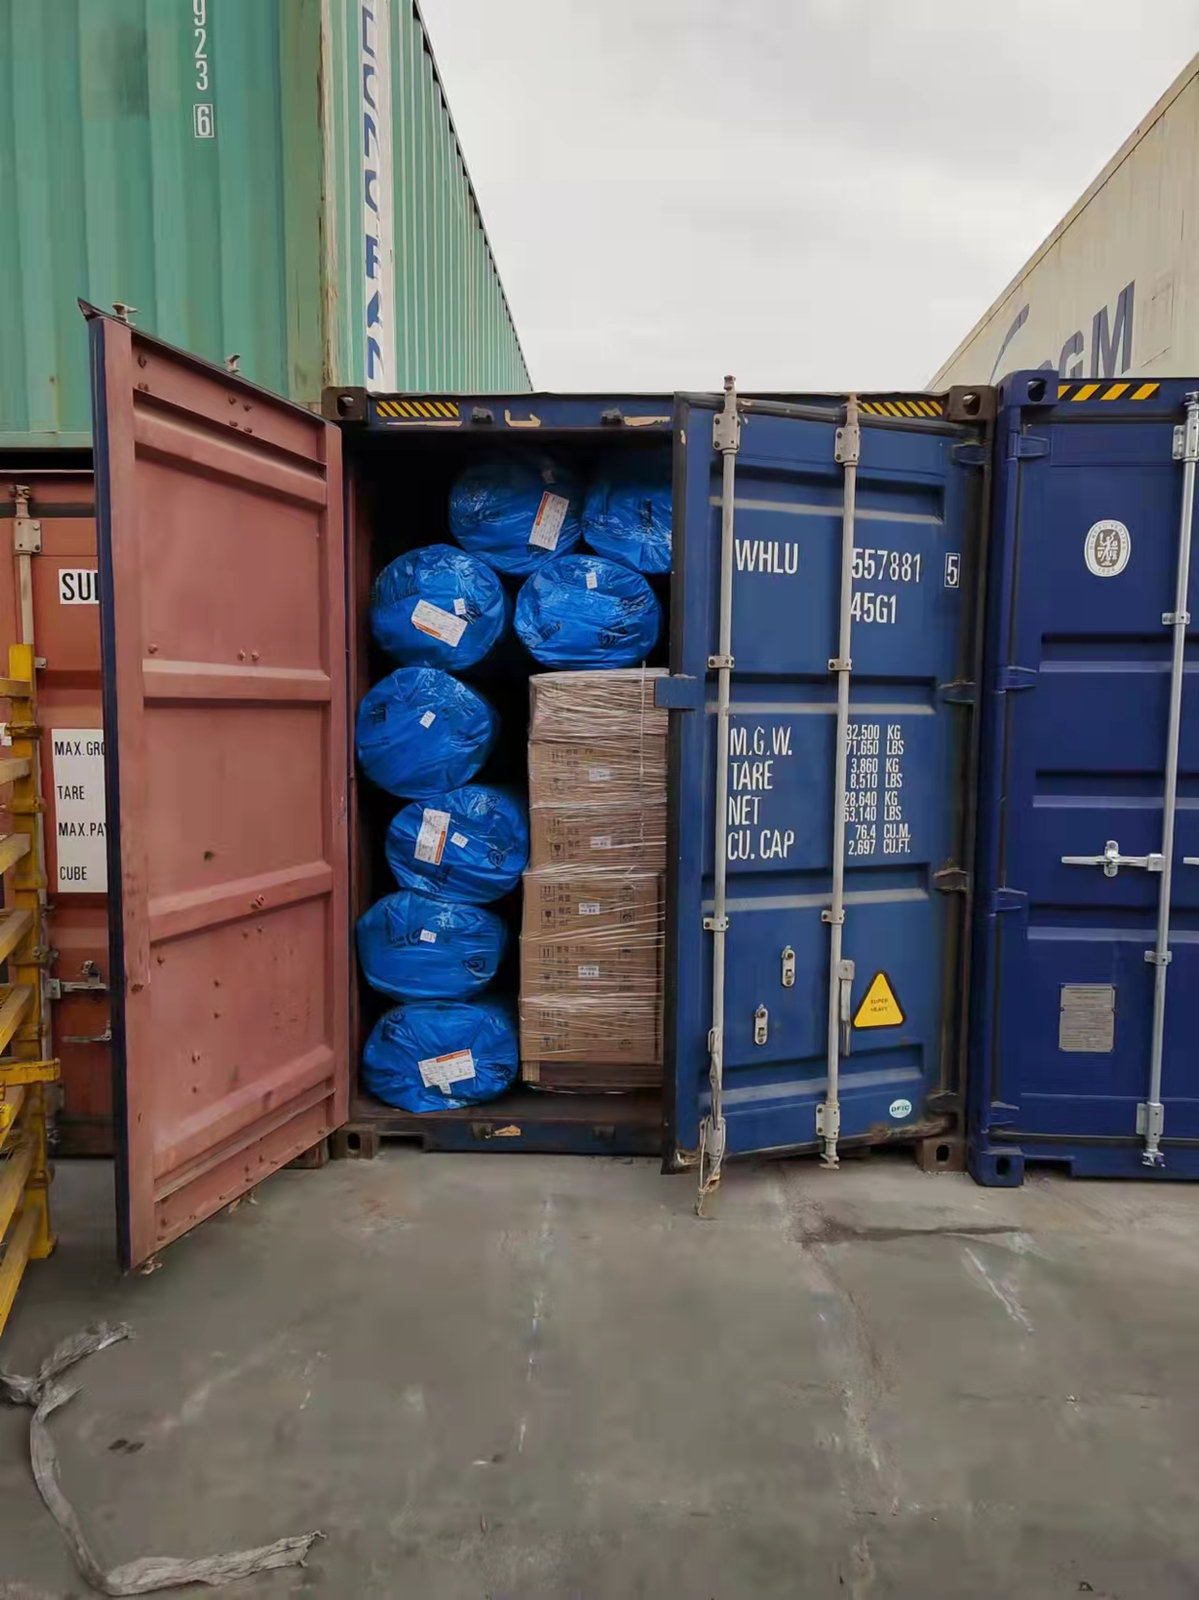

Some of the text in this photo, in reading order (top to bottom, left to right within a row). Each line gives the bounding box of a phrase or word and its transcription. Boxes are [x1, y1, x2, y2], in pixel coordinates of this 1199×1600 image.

[196, 105, 211, 137] 6
[735, 539, 959, 586] WHLU 557881 5
[850, 591, 897, 624] 45G1
[846, 724, 880, 741] 32,500
[887, 724, 901, 740] KG
[846, 740, 905, 756] 71,650 LBS
[730, 758, 900, 791] TARE 3,860 KG
[850, 773, 903, 790] 8,510 LBS
[57, 785, 85, 800] TARE
[728, 790, 898, 826] NET 28,640 KG
[883, 806, 902, 821] LBS
[759, 828, 795, 860] CAP
[855, 823, 877, 840] 76.4
[883, 823, 912, 839] CU.M.
[848, 840, 876, 856] 2,697
[59, 866, 88, 881] CUBE
